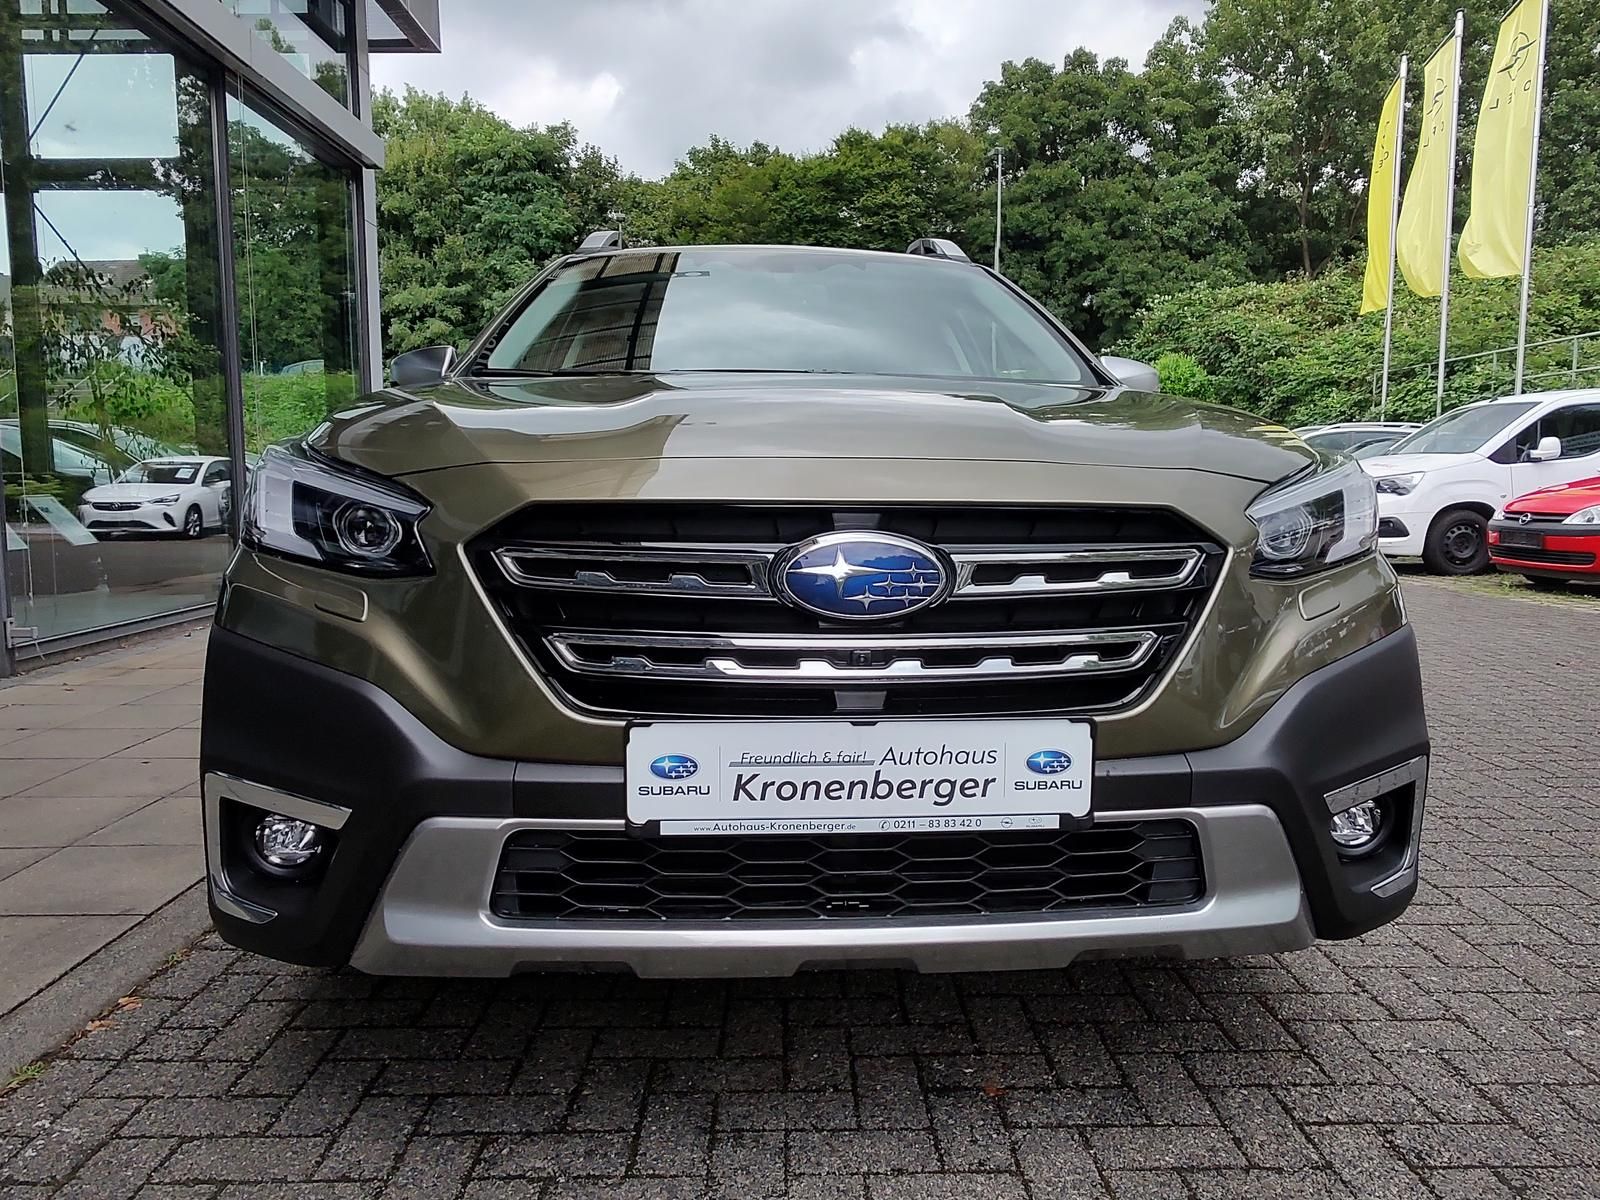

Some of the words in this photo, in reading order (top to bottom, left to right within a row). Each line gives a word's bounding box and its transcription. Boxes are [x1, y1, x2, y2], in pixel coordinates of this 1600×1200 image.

[740, 750, 818, 764] Freundlich
[822, 751, 833, 763] &
[836, 750, 867, 763] fair!
[878, 743, 998, 766] Autohaus
[638, 785, 711, 796] SUBARU
[732, 769, 997, 807] Kronenberger
[1014, 779, 1083, 791] SUBARU
[693, 821, 857, 832] www.Autohaus-Kronenberger.de
[893, 819, 916, 829] 0211
[927, 819, 941, 829] 83
[943, 818, 957, 828] 83
[959, 818, 973, 828] 42
[975, 818, 982, 828] 0
